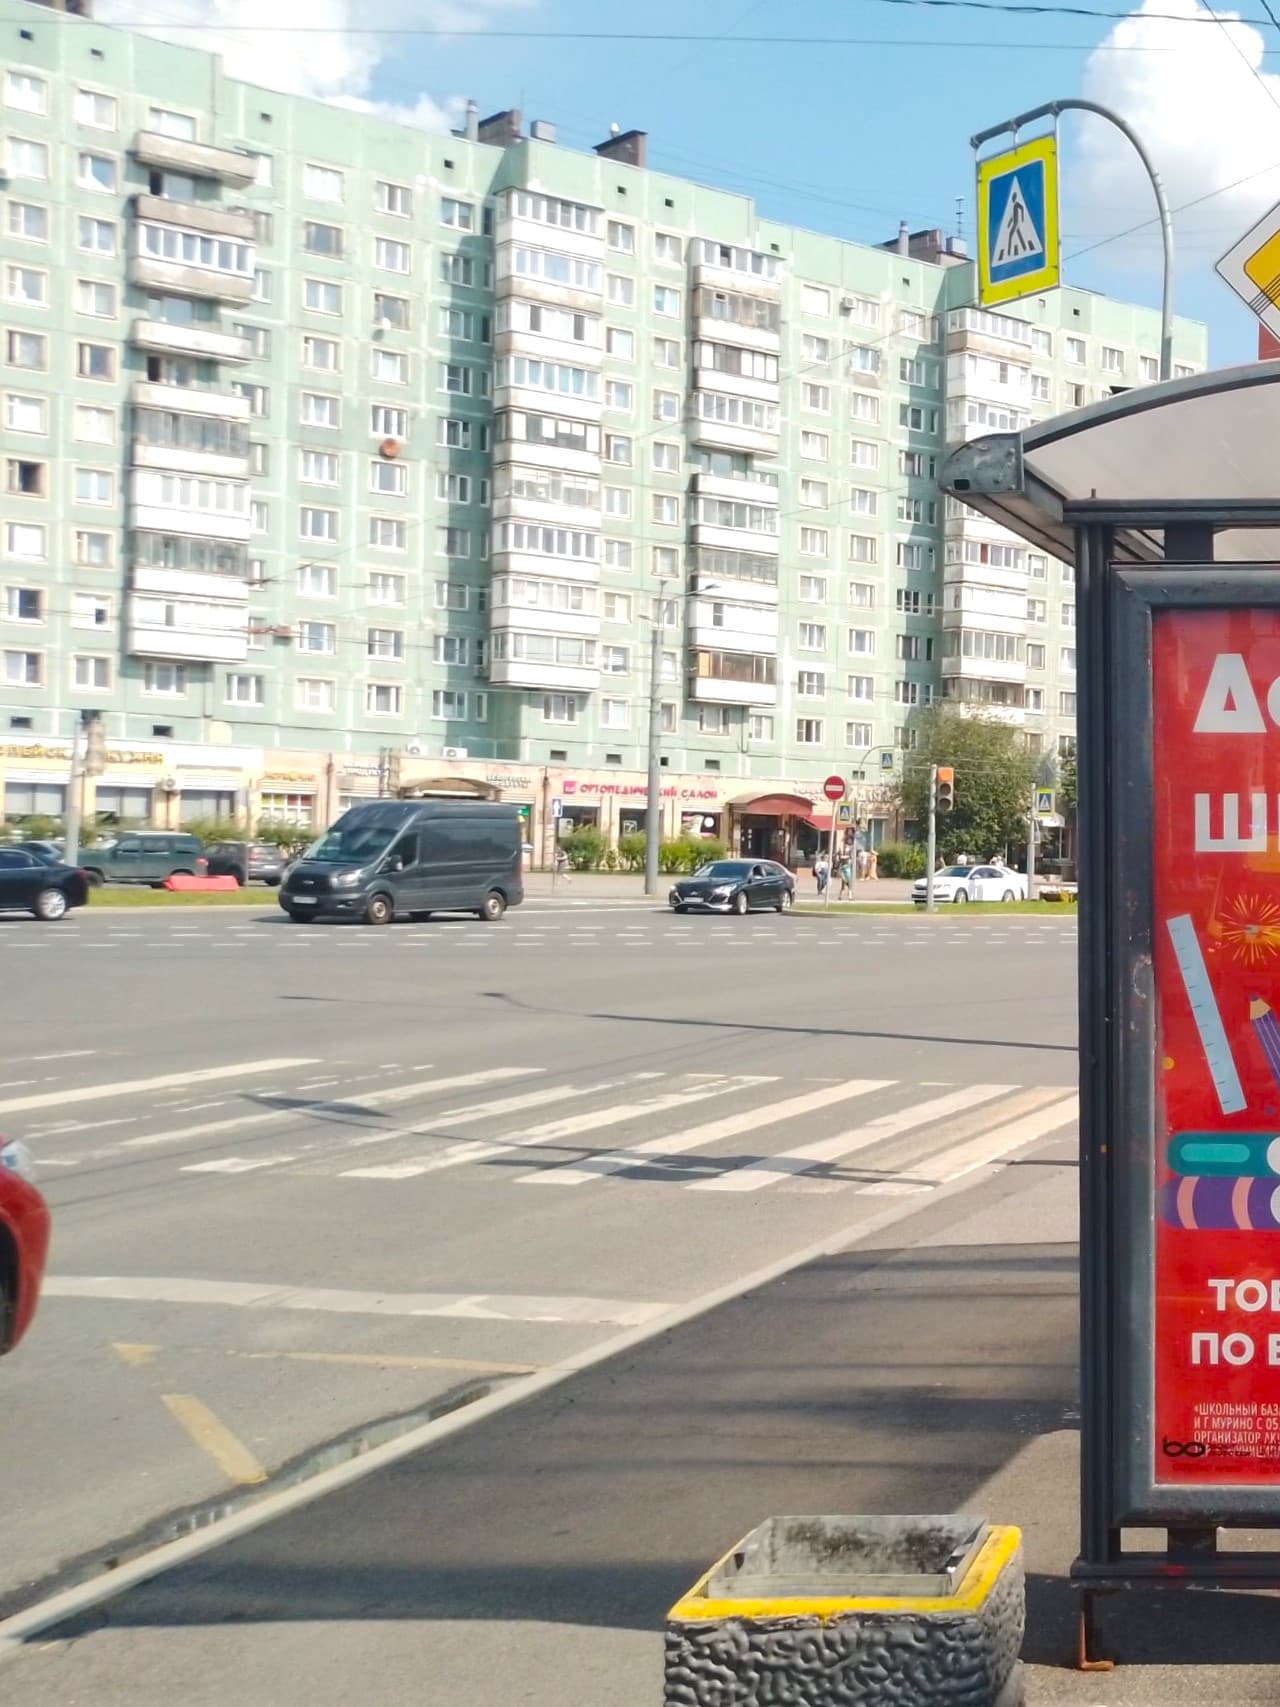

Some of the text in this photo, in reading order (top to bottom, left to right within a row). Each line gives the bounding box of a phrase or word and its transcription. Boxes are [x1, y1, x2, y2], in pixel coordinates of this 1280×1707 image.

[681, 788, 718, 800] САЛОН
[1191, 1332, 1255, 1366] ПО
[1194, 1402, 1257, 1416] «ШКОЛЬНЫЙ
[1193, 1416, 1201, 1429] И
[1256, 1417, 1263, 1430] С
[1193, 1431, 1261, 1444] ОРГАНИЗАТОР
